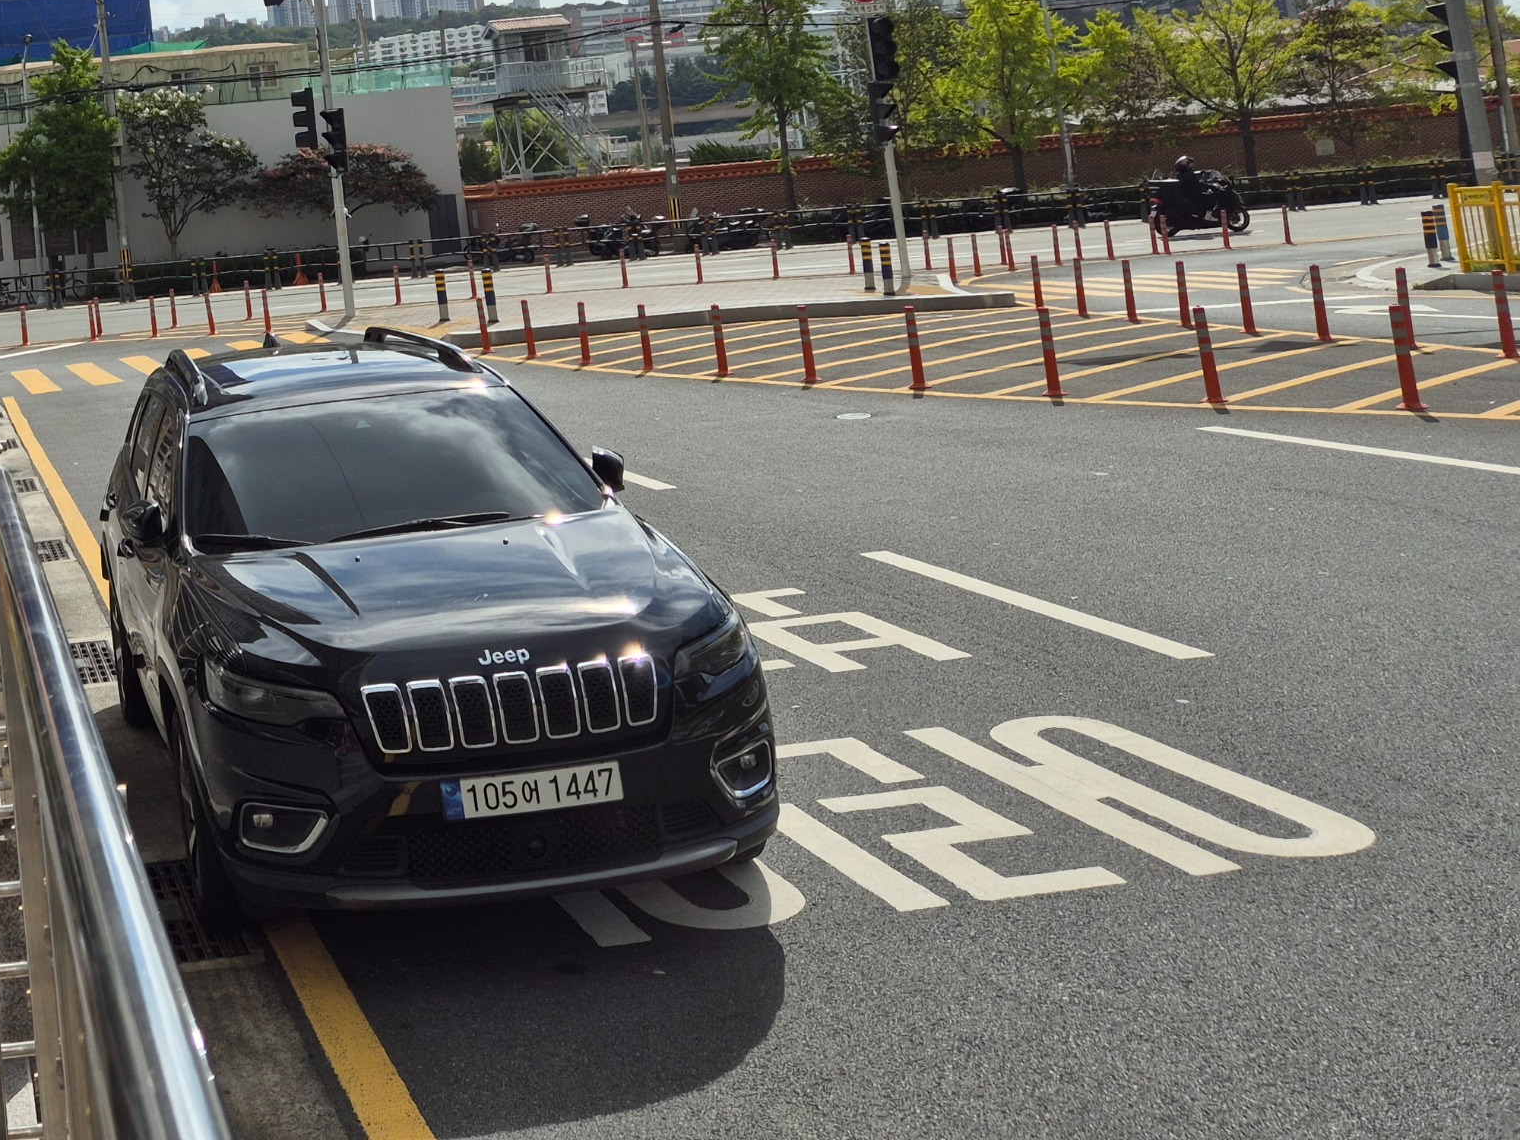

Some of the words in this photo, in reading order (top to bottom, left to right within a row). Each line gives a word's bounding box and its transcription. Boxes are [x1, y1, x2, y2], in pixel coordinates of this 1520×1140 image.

[477, 645, 531, 667] Jeep
[466, 779, 541, 812] 105어
[548, 767, 613, 803] 1447
